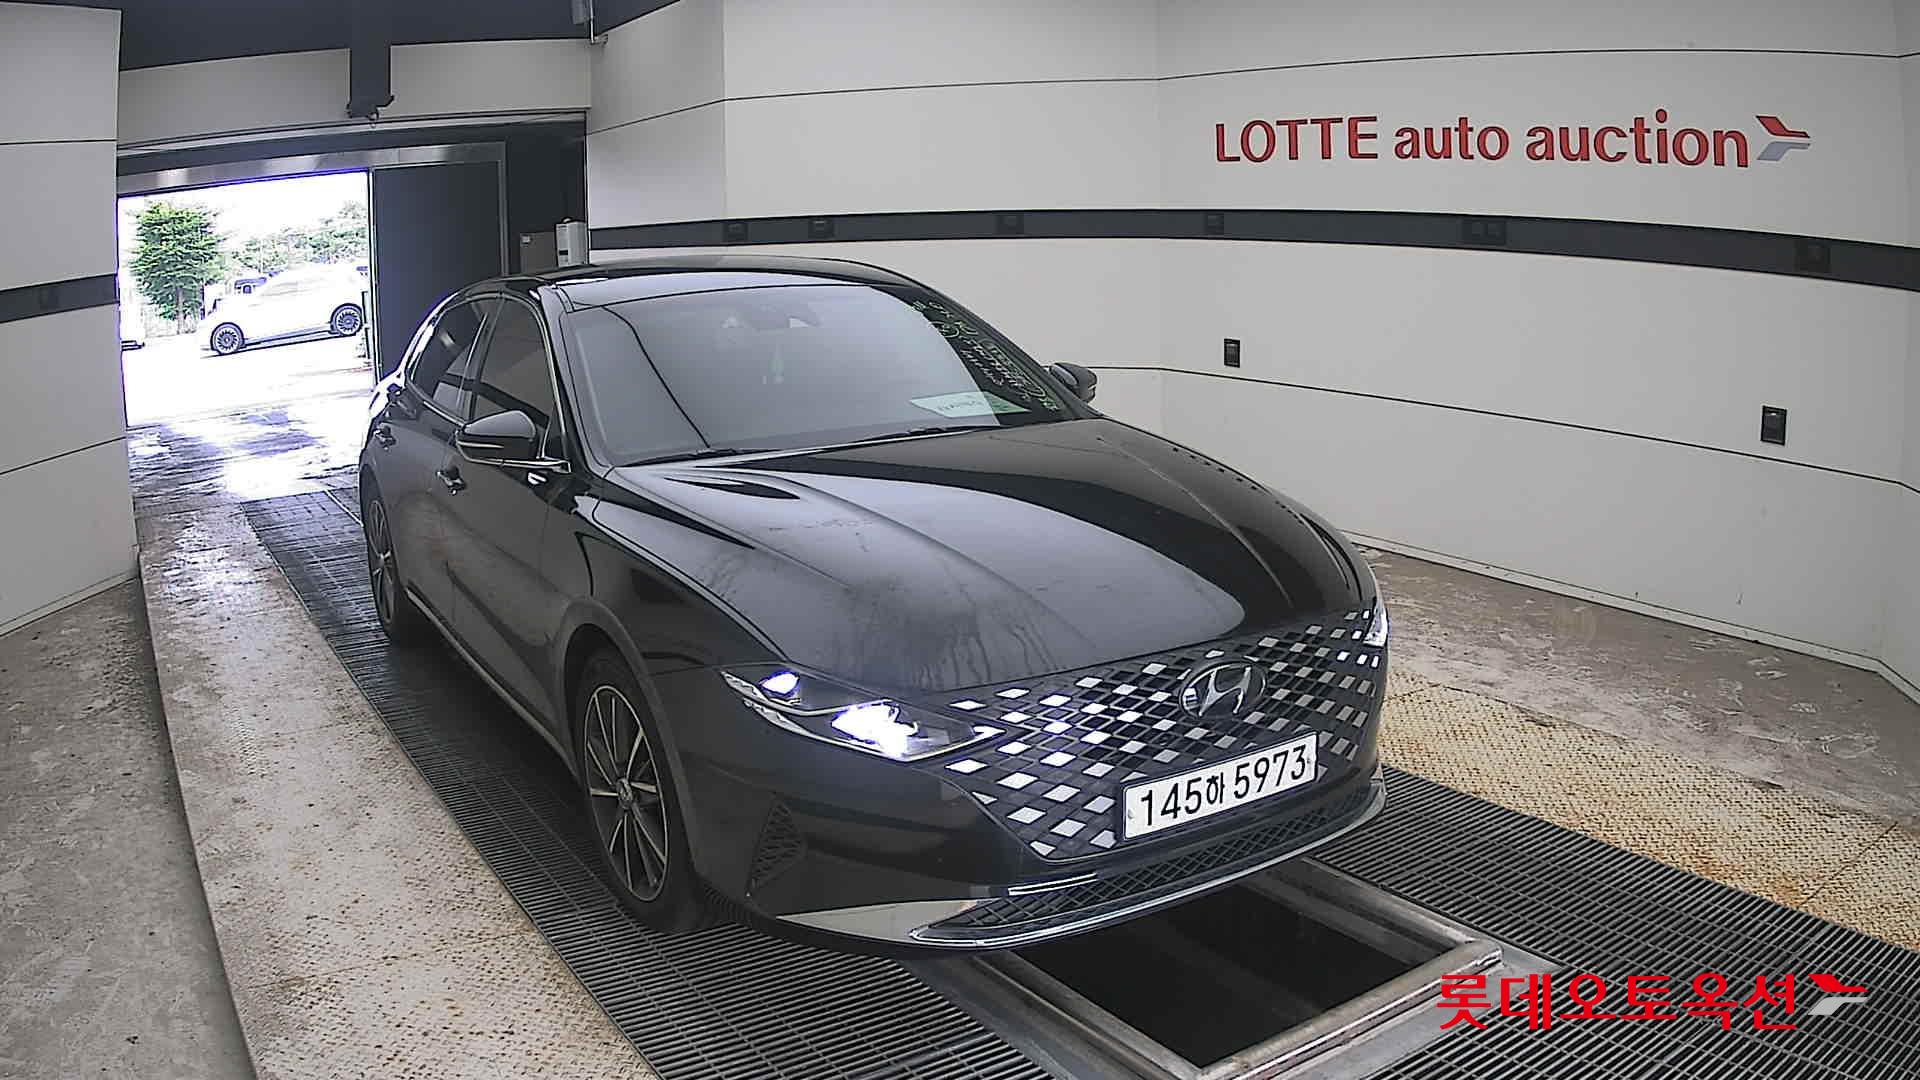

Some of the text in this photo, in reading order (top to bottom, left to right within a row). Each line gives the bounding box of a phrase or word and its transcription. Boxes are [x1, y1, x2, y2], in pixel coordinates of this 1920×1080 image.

[1216, 109, 1749, 168] LOTTE auto auction
[1233, 744, 1306, 799] 5973
